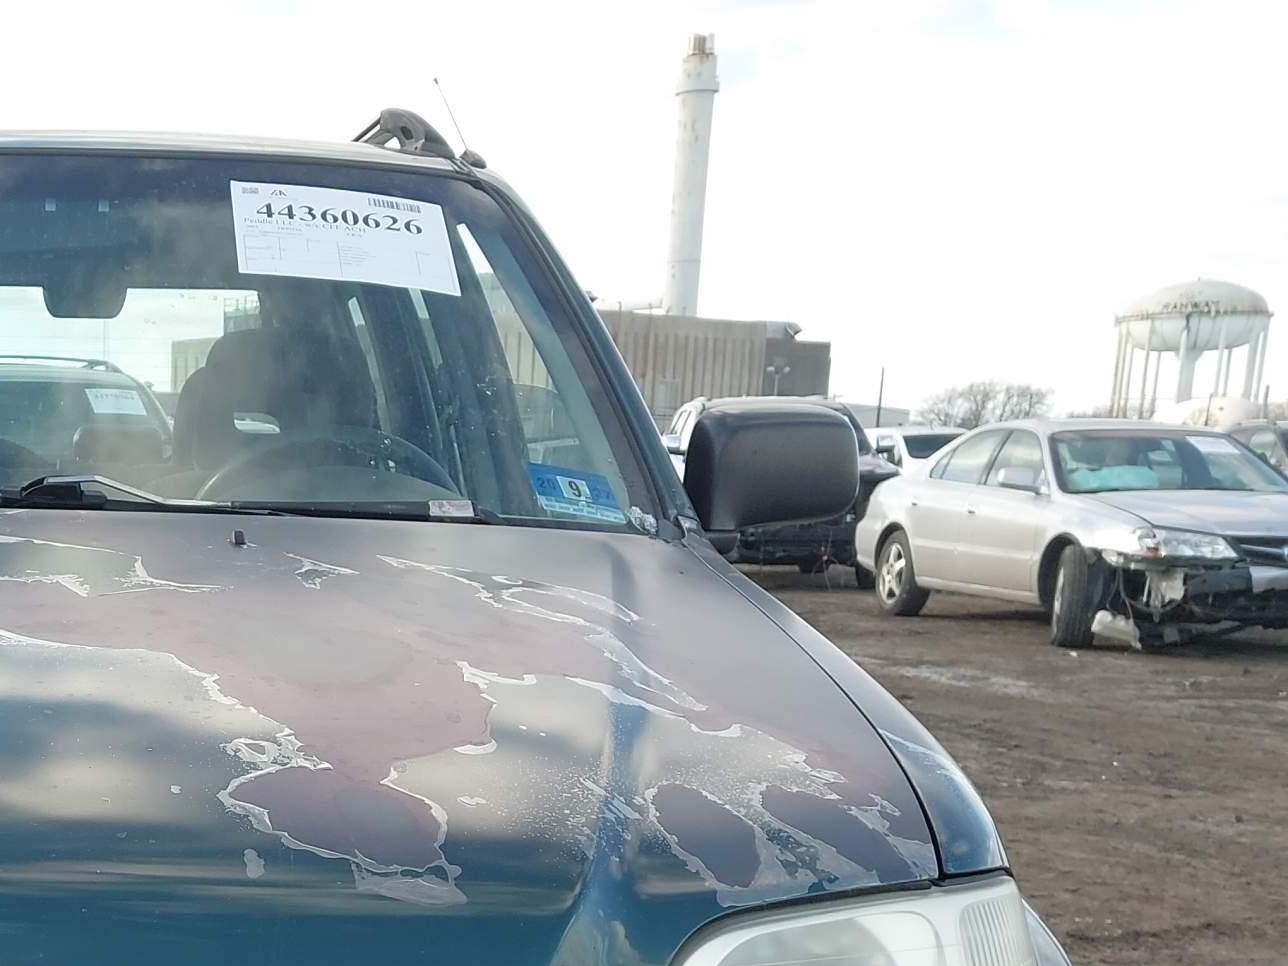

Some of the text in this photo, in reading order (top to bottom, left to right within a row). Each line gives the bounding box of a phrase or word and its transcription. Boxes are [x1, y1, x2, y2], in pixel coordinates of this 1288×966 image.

[256, 202, 423, 235] 44360626
[1163, 301, 1220, 311] RAHWAY
[568, 480, 582, 498] 9
